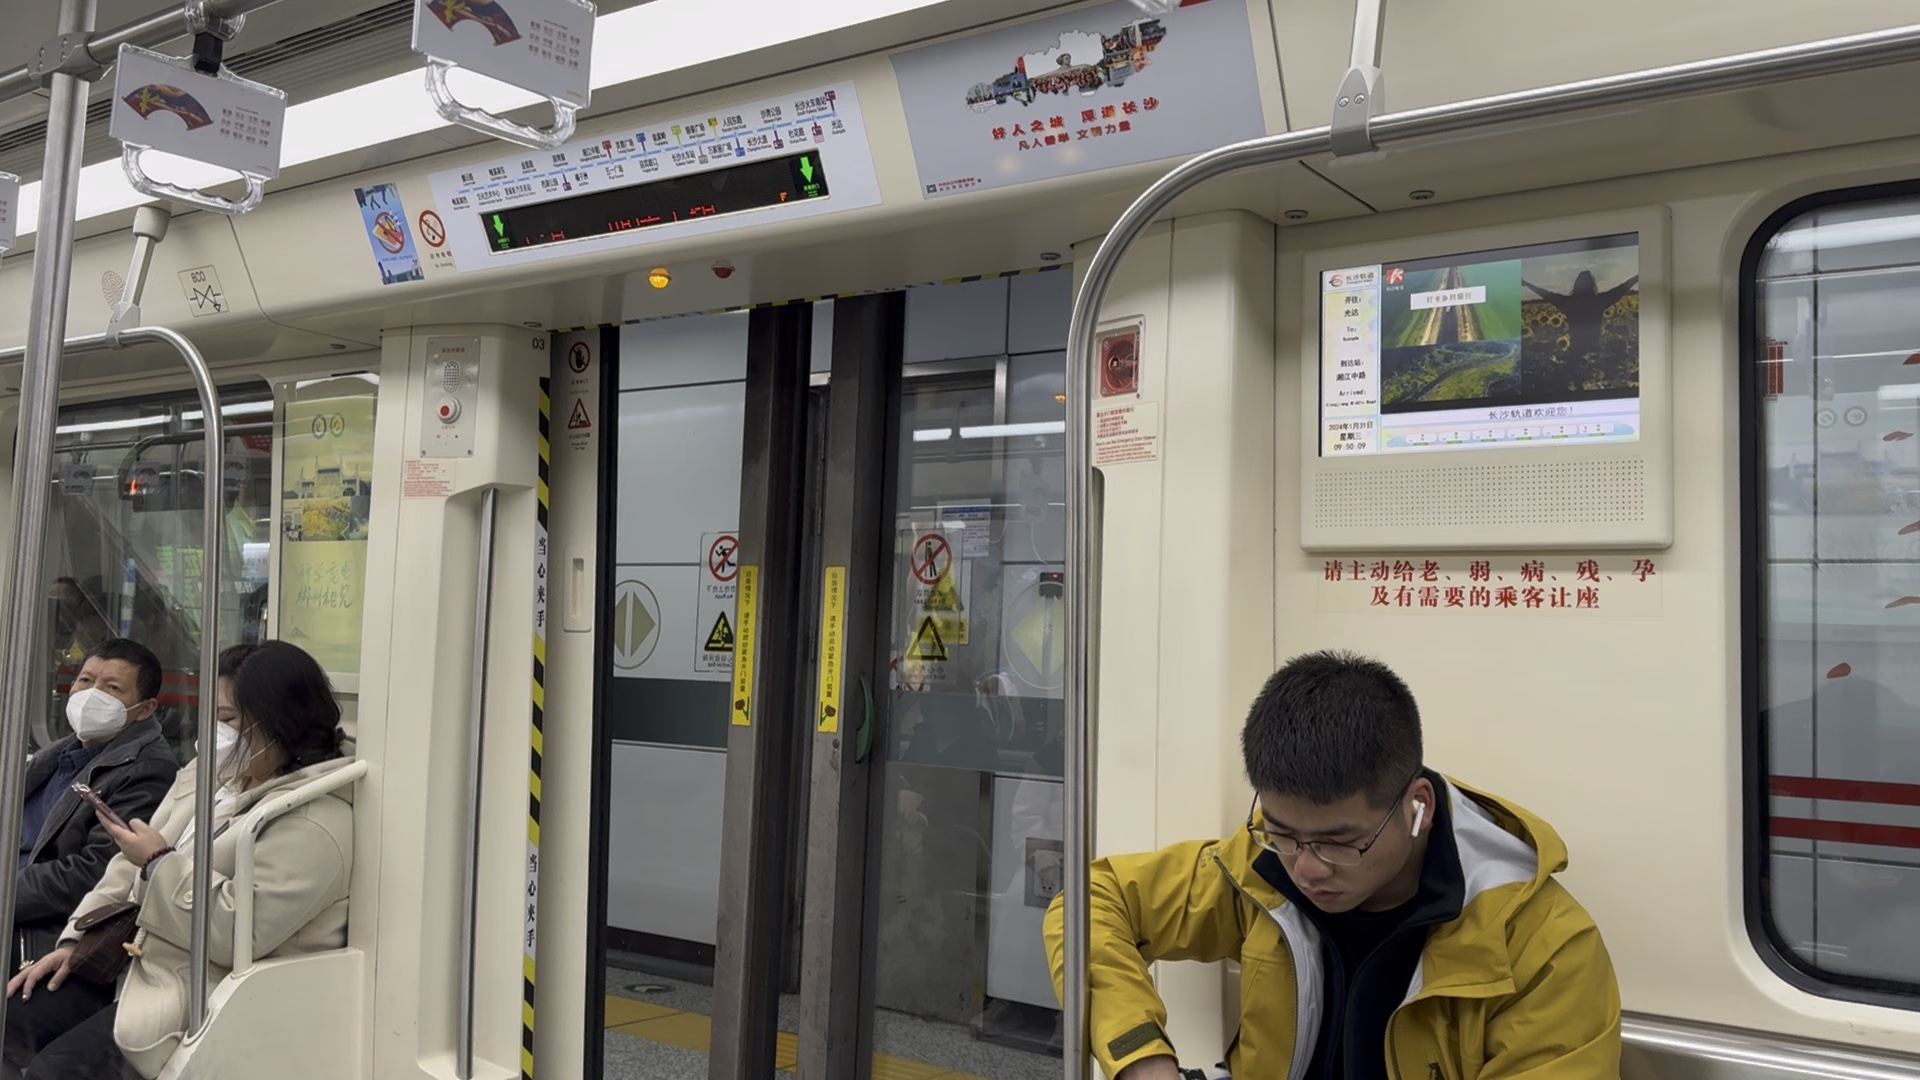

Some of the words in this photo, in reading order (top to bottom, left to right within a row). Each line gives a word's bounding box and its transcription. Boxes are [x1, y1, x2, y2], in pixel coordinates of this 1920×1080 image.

[992, 115, 1065, 141] 好人之城
[1081, 96, 1160, 123] 厚道长沙
[1077, 120, 1132, 140] 文明力量
[1344, 309, 1359, 317] 光达
[532, 338, 545, 350] 03
[1336, 371, 1366, 381] 湘江中路
[1329, 421, 1374, 431] 2024年1月31日
[1340, 432, 1362, 441] 星期三
[1323, 558, 1656, 583] 请主动给老、弱、病、残、孕
[536, 536, 547, 628] 当心夹手
[1370, 585, 1600, 609] 及有需要的乘客让座
[526, 853, 537, 948] 当心夹手
